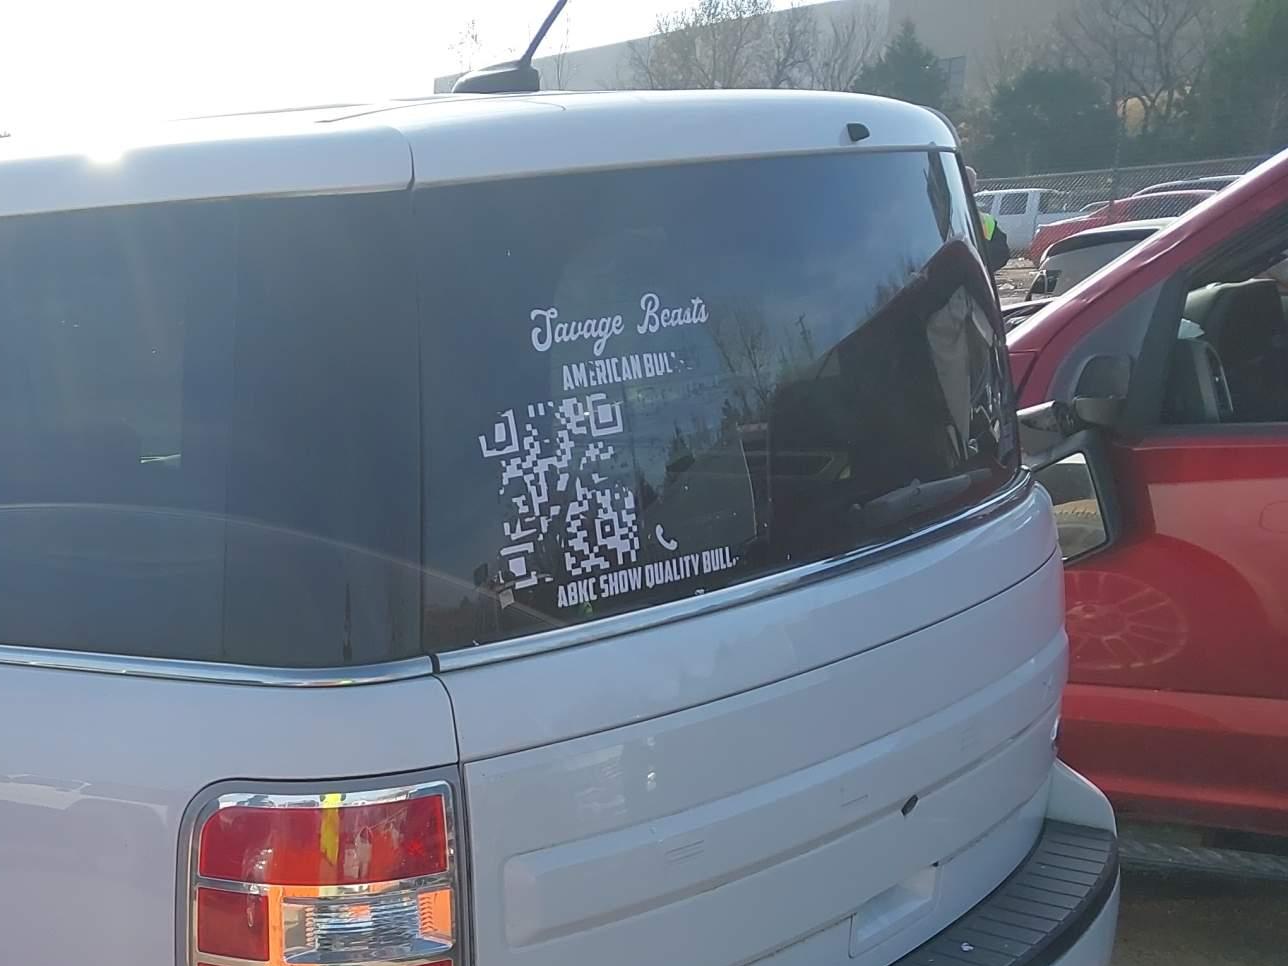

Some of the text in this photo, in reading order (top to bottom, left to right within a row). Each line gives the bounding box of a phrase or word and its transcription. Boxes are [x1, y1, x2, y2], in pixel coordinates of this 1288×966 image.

[637, 293, 709, 334] Beasts
[562, 351, 677, 391] AMERICAN BUL
[557, 546, 739, 608] ABKC SHOW QUALITY BULL
